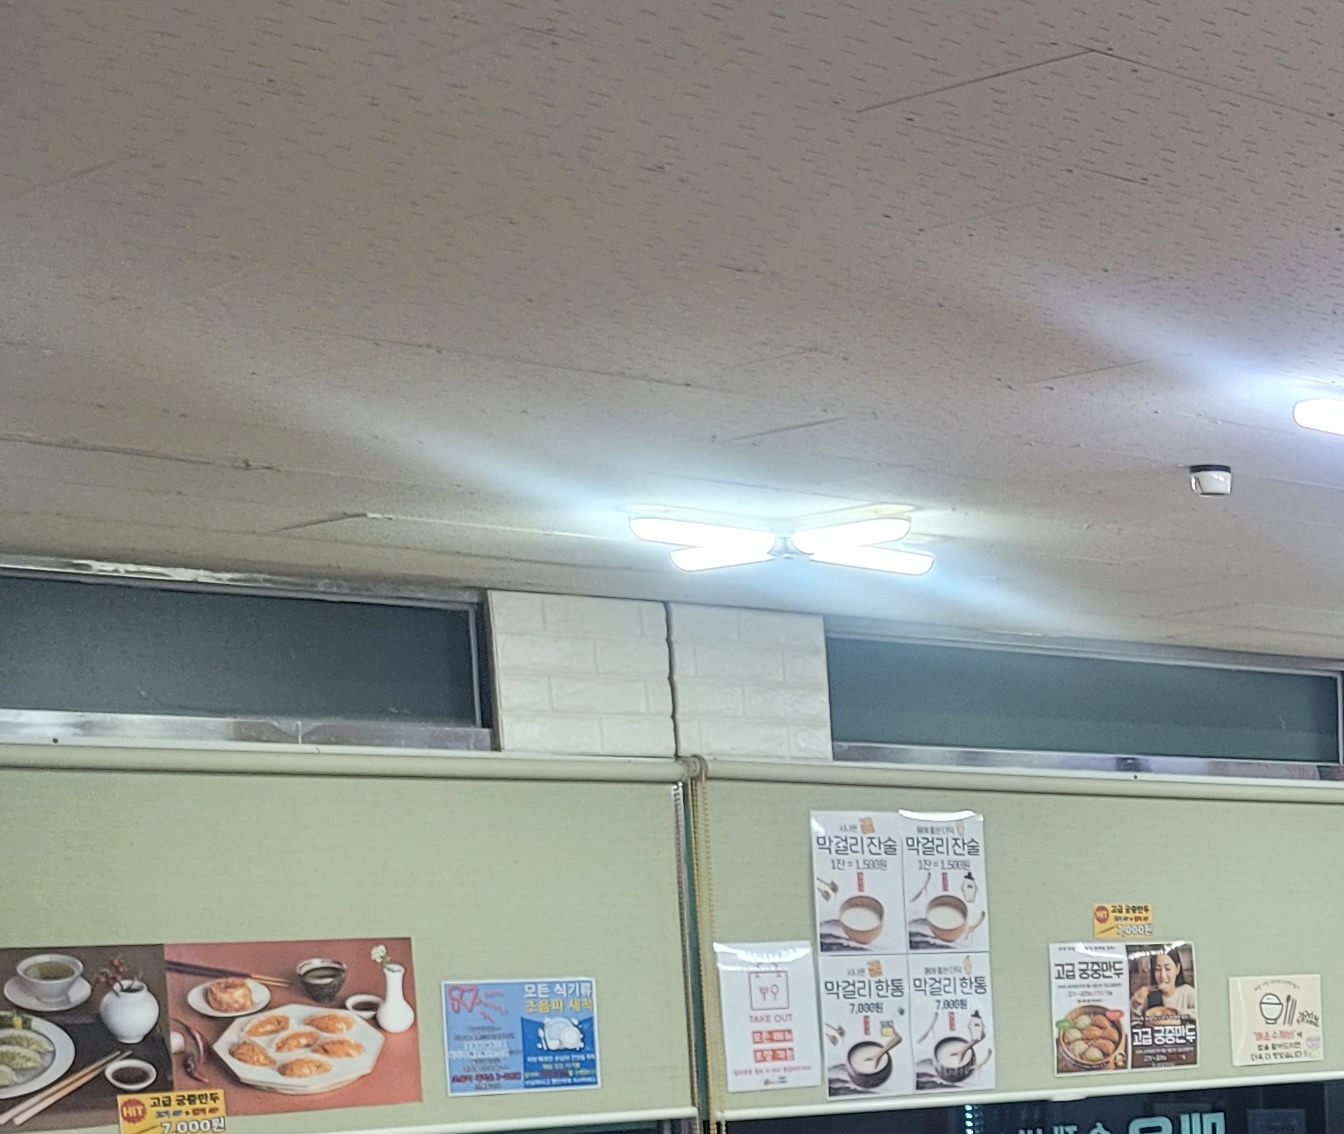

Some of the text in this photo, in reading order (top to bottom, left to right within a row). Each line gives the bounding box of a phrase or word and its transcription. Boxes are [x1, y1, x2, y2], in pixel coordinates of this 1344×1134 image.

[817, 836, 898, 855] 막걸리 잔술
[906, 836, 980, 856] 막걸리 잔술
[1054, 960, 1124, 980] 고급 궁중만두
[524, 982, 592, 998] 모든 식기류
[825, 979, 904, 1000] 막걸리 한통
[913, 976, 987, 996] 막걸리 한통
[749, 1014, 792, 1023] TAKE OUT
[1132, 1025, 1196, 1045] 고급 궁중만두
[150, 1092, 220, 1107] 고급 궁중만두
[122, 1106, 144, 1117] HIT
